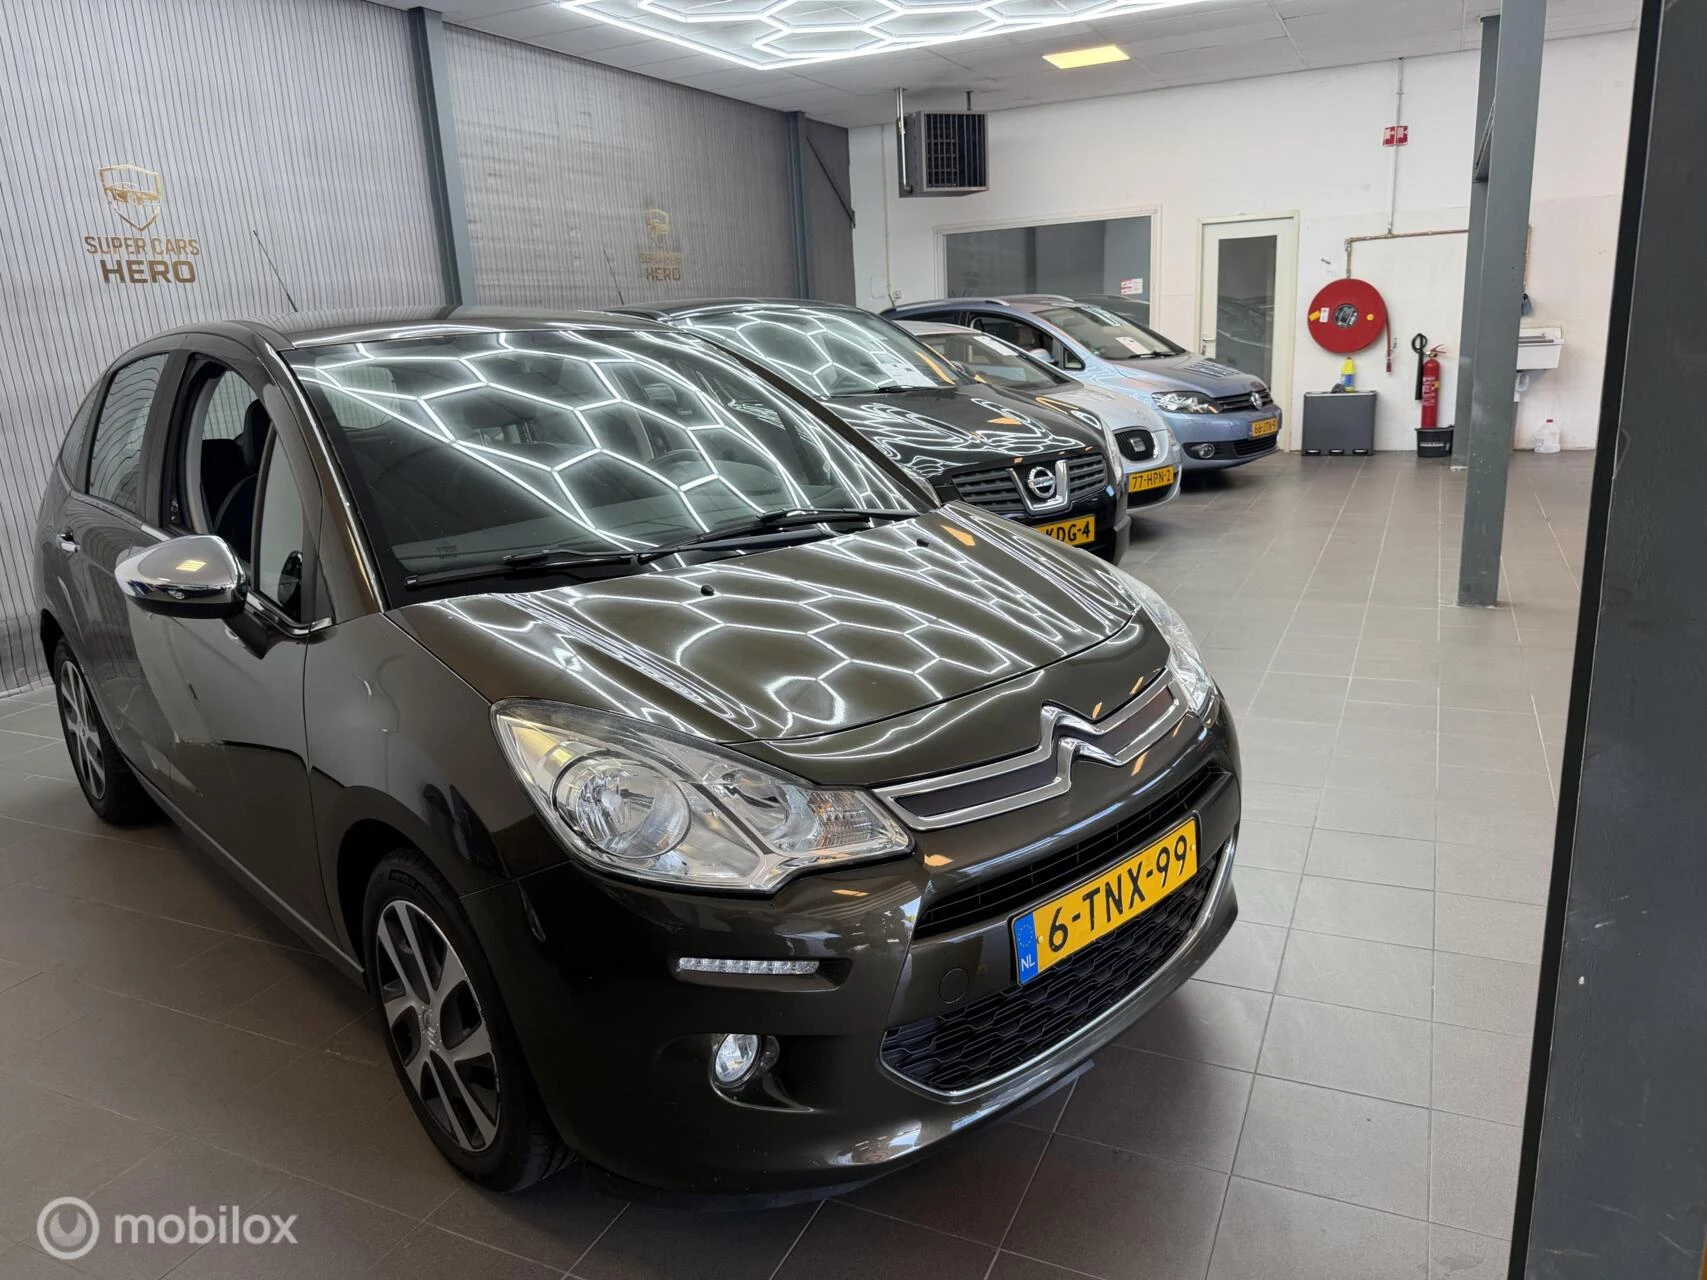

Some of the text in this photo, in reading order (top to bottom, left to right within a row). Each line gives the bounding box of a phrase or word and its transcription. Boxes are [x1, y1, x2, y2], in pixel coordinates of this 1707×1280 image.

[84, 236, 200, 256] SUPER CARS
[100, 259, 196, 284] HERO
[646, 267, 681, 281] HERO
[1132, 469, 1172, 490] 77-HPN-2
[1048, 834, 1188, 953] 6-TNX-99
[1020, 957, 1036, 973] NL
